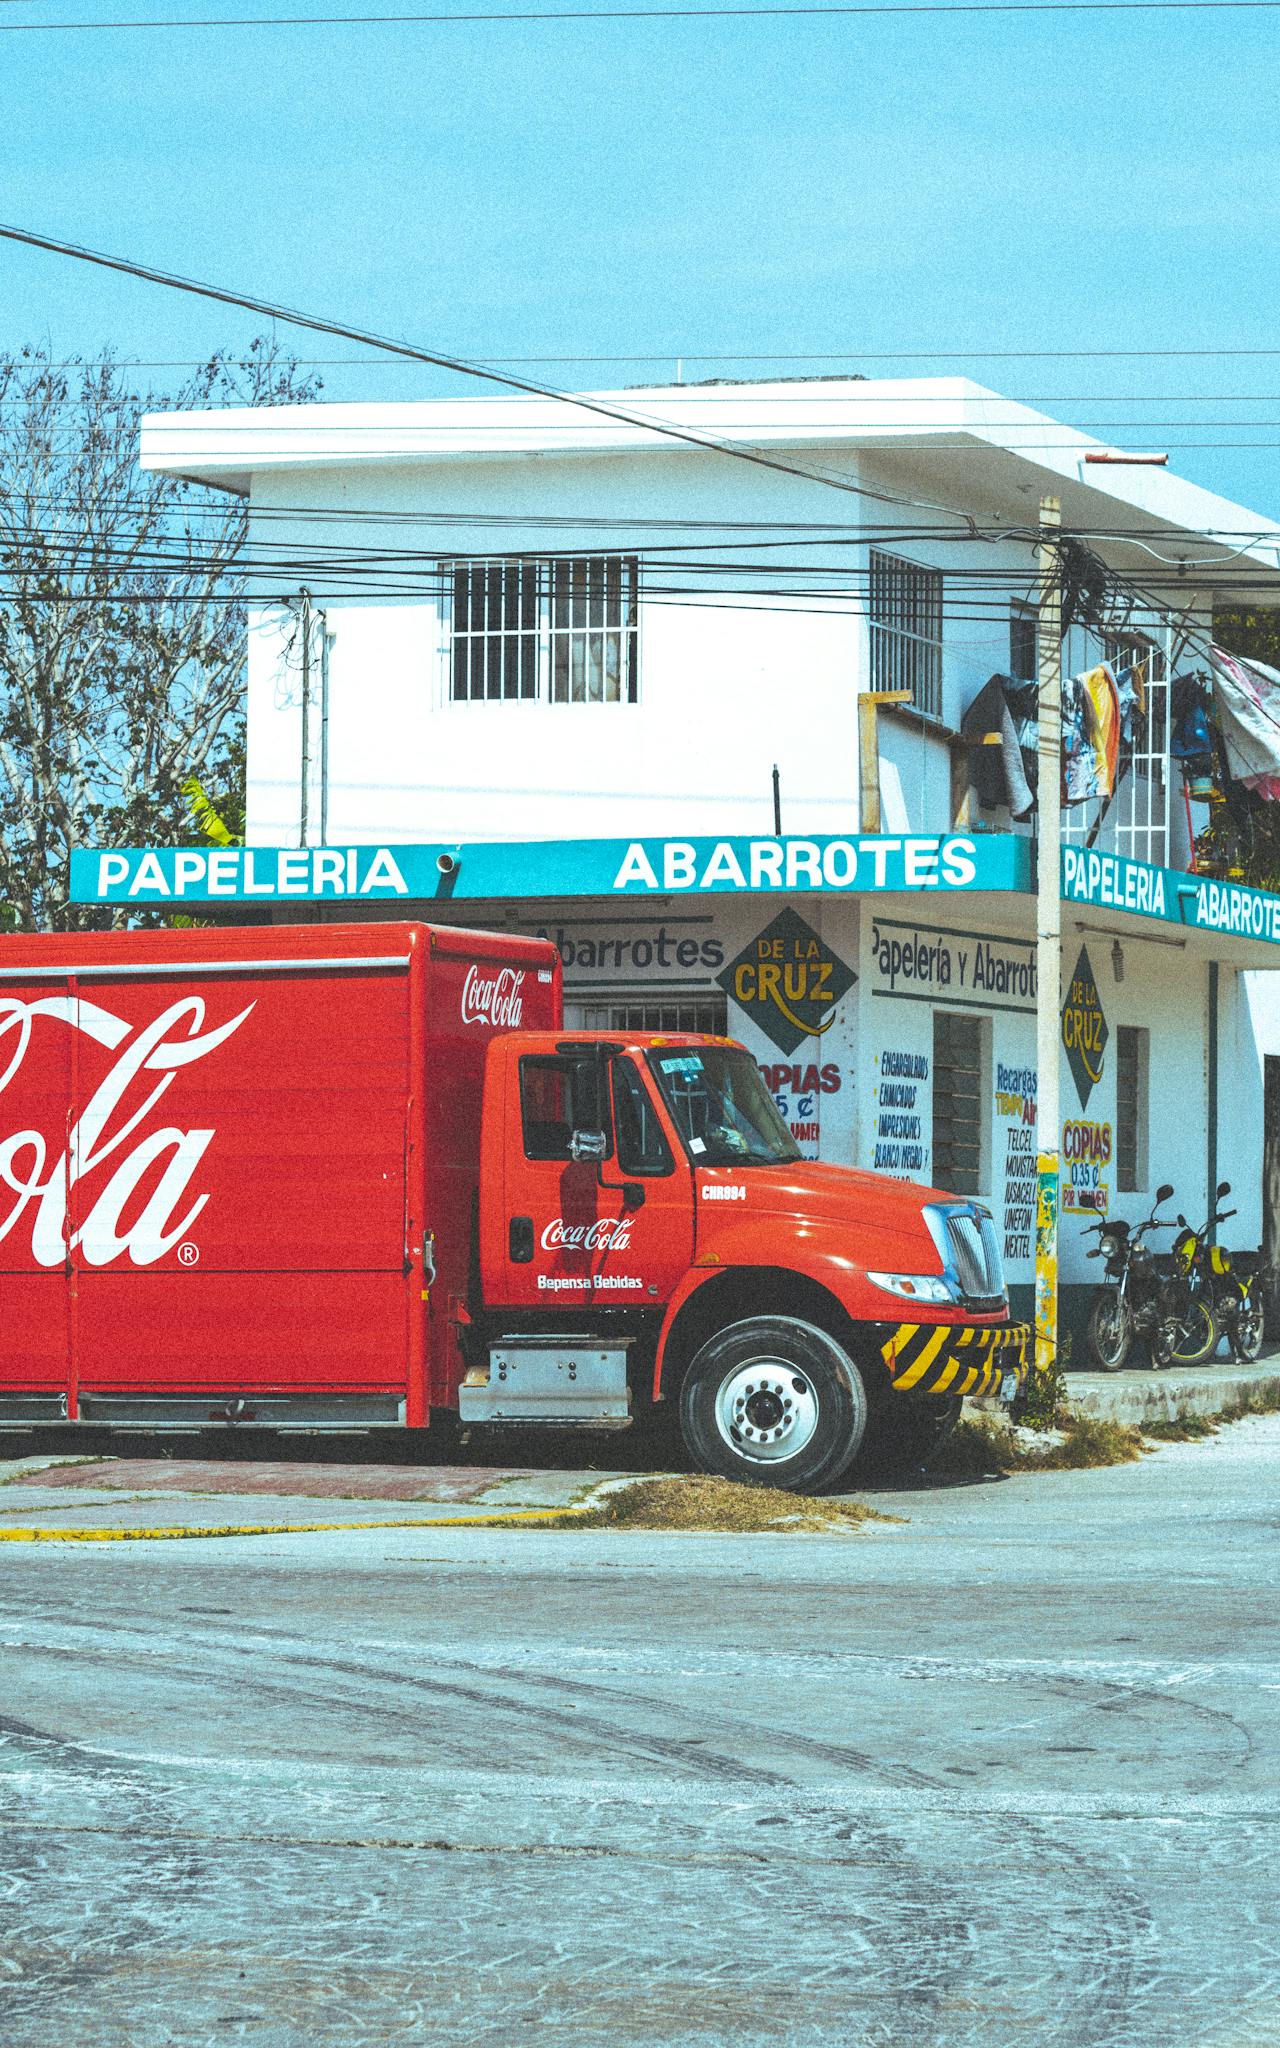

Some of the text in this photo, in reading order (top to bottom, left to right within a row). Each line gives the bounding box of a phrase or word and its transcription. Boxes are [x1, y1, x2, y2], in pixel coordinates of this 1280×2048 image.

[98, 849, 410, 896] PAPELERIA
[612, 838, 976, 888] ABARROTES
[1064, 849, 1166, 915] PAPELERIA
[1196, 883, 1280, 939] ABARROTE
[757, 939, 820, 960] DE LA
[972, 942, 1061, 998] Abarrot
[1072, 980, 1097, 1006] DE LA
[997, 1064, 1037, 1099] Recargas
[878, 1114, 921, 1140] IMPRESIONES
[1007, 1127, 1032, 1152] TELCEL
[1063, 1121, 1111, 1163] COPIAS
[1004, 1208, 1032, 1231] UNEFON
[1004, 1234, 1030, 1259] NEXTEL
[537, 1275, 643, 1293] Bepensa Bebidas
